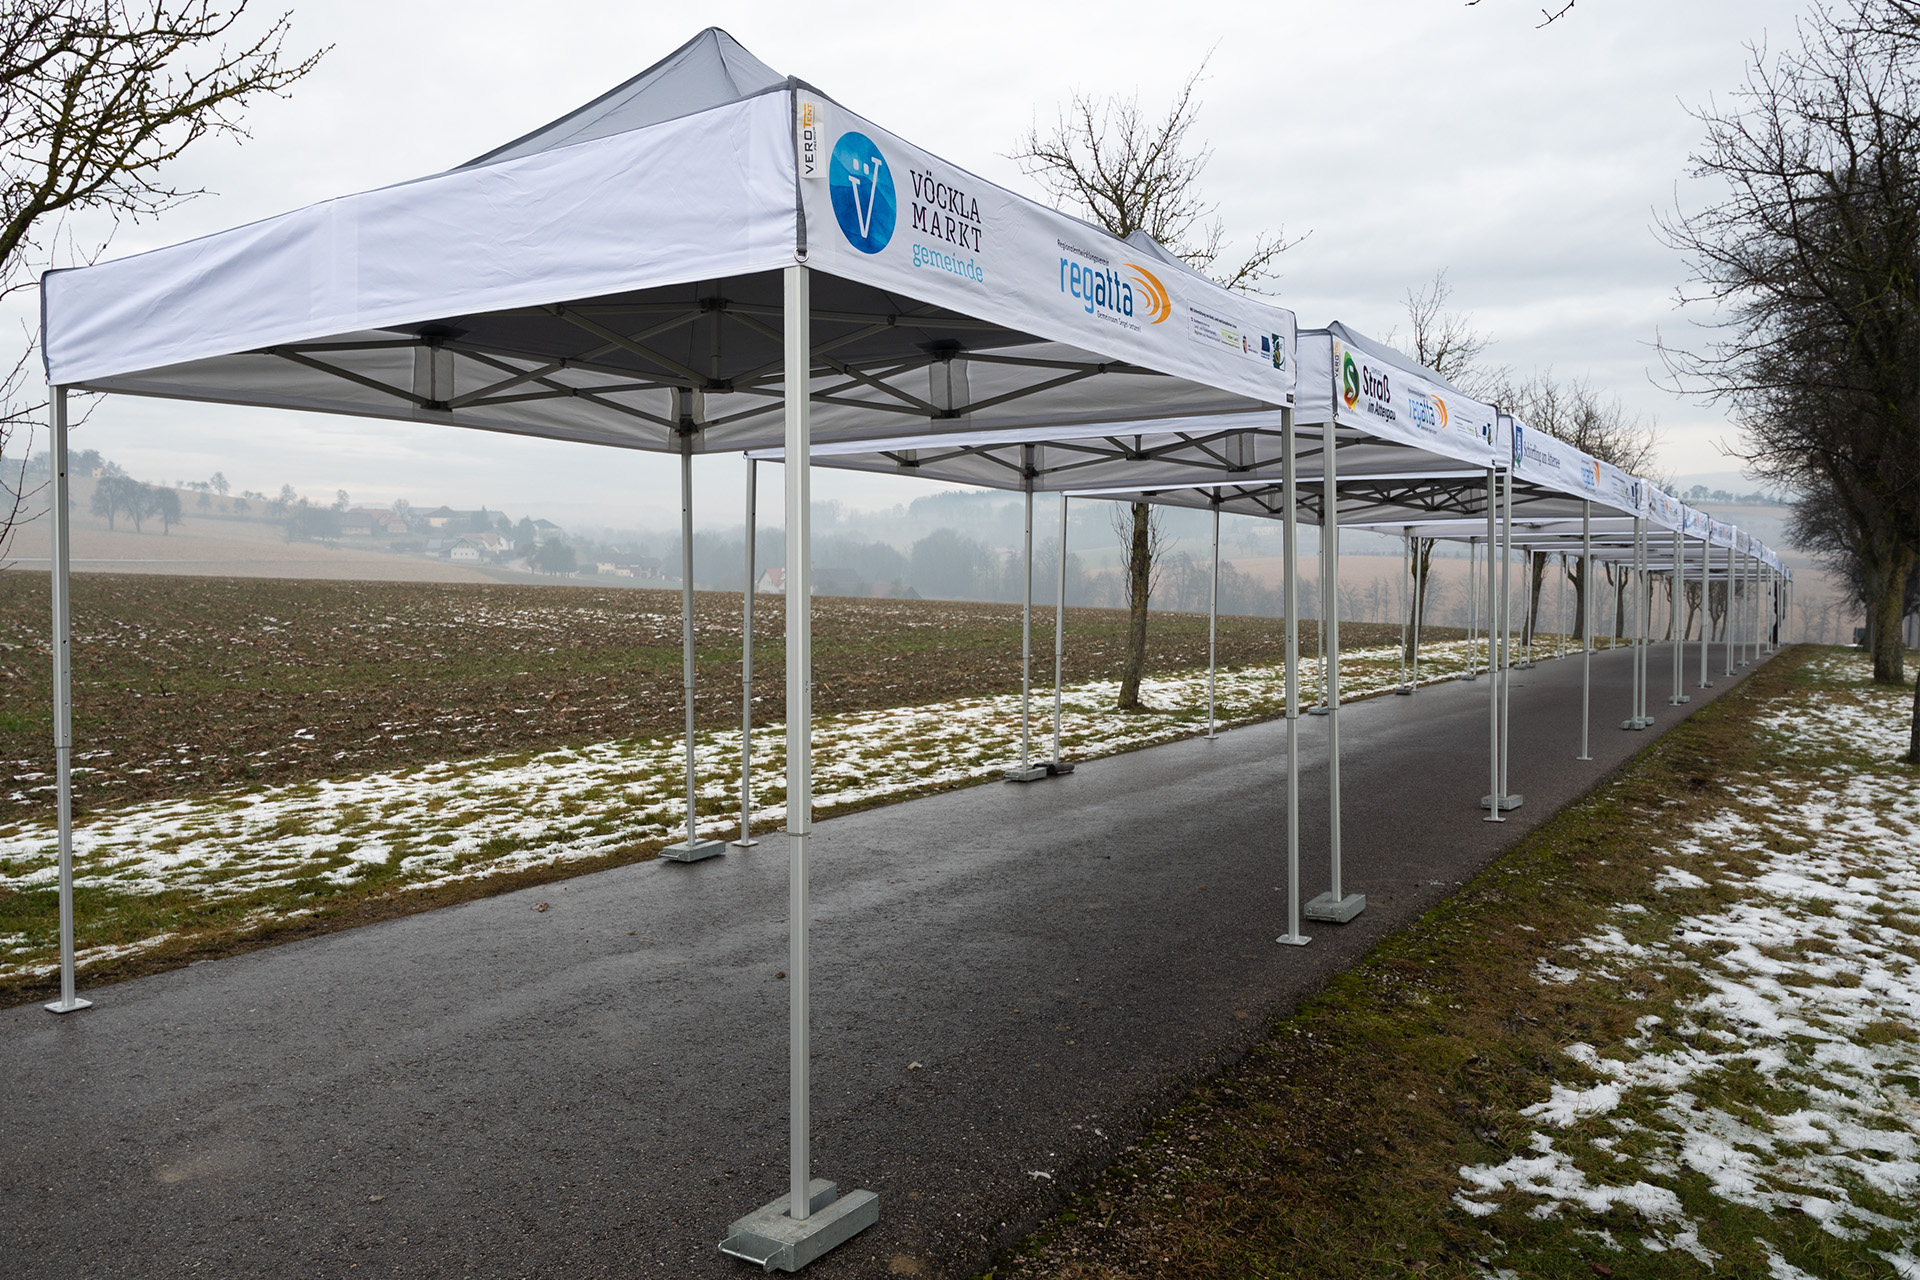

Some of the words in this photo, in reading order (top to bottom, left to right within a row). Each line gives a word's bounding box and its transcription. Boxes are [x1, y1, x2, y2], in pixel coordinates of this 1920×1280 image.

[909, 169, 982, 224] VÖCKLA
[911, 201, 982, 253] MARKT
[912, 243, 984, 283] gemeinde
[1060, 257, 1133, 318] regatta
[1363, 365, 1391, 403] Straß
[1367, 398, 1374, 414] im
[1408, 398, 1435, 428] regatta
